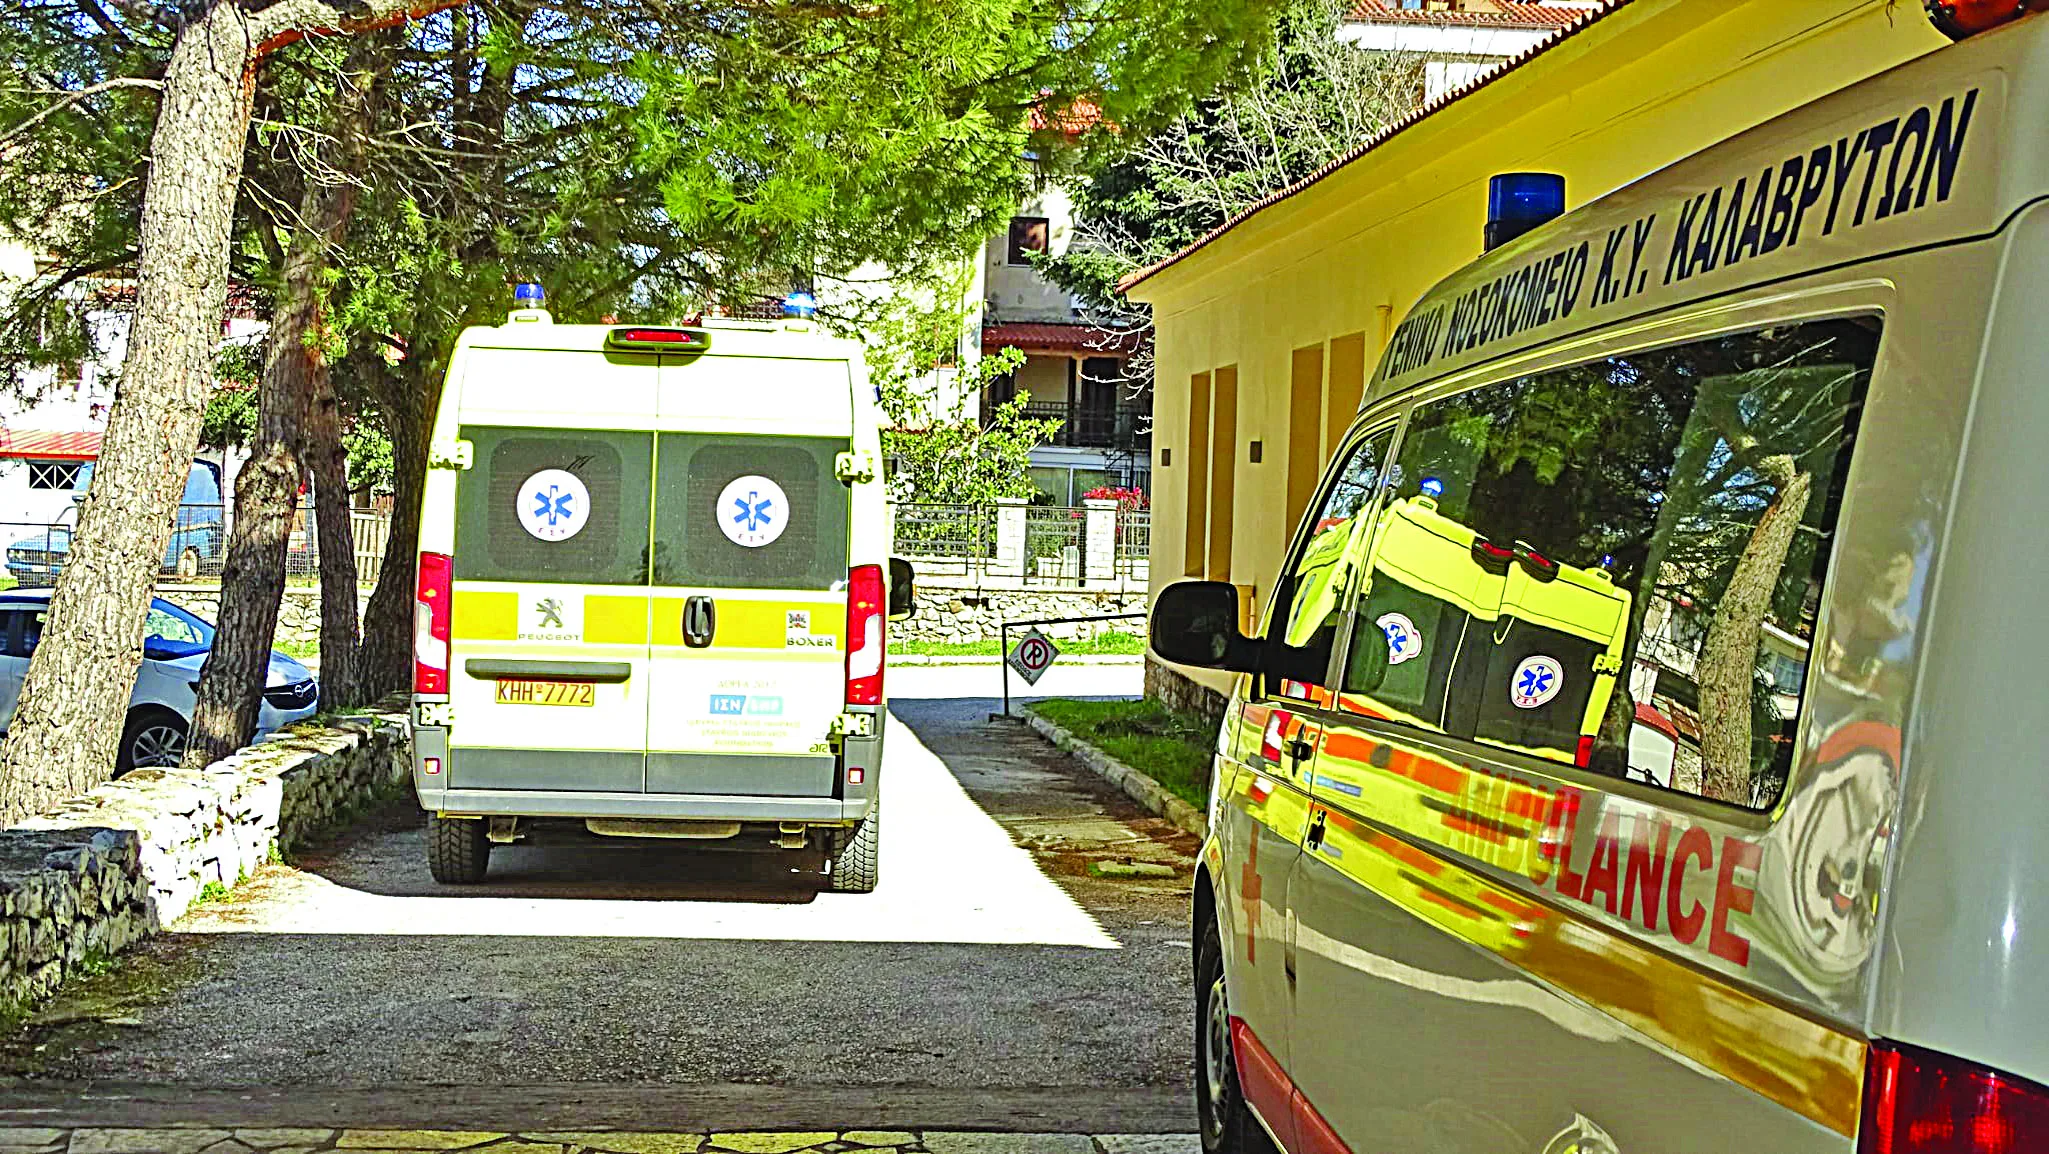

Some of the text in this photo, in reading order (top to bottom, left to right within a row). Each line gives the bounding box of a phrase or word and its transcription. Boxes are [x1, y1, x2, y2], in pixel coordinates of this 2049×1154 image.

[1382, 88, 1979, 382] ΓΕΝΙΚΟ ΝΟΣΟΚΟΜΕΙΟ Κ.Υ. ΚΑΛΑΒΡΥΤΩΝ
[518, 633, 580, 641] PEUGEOT
[787, 637, 833, 647] BOXER
[1449, 762, 1765, 968] AMBULANCE
